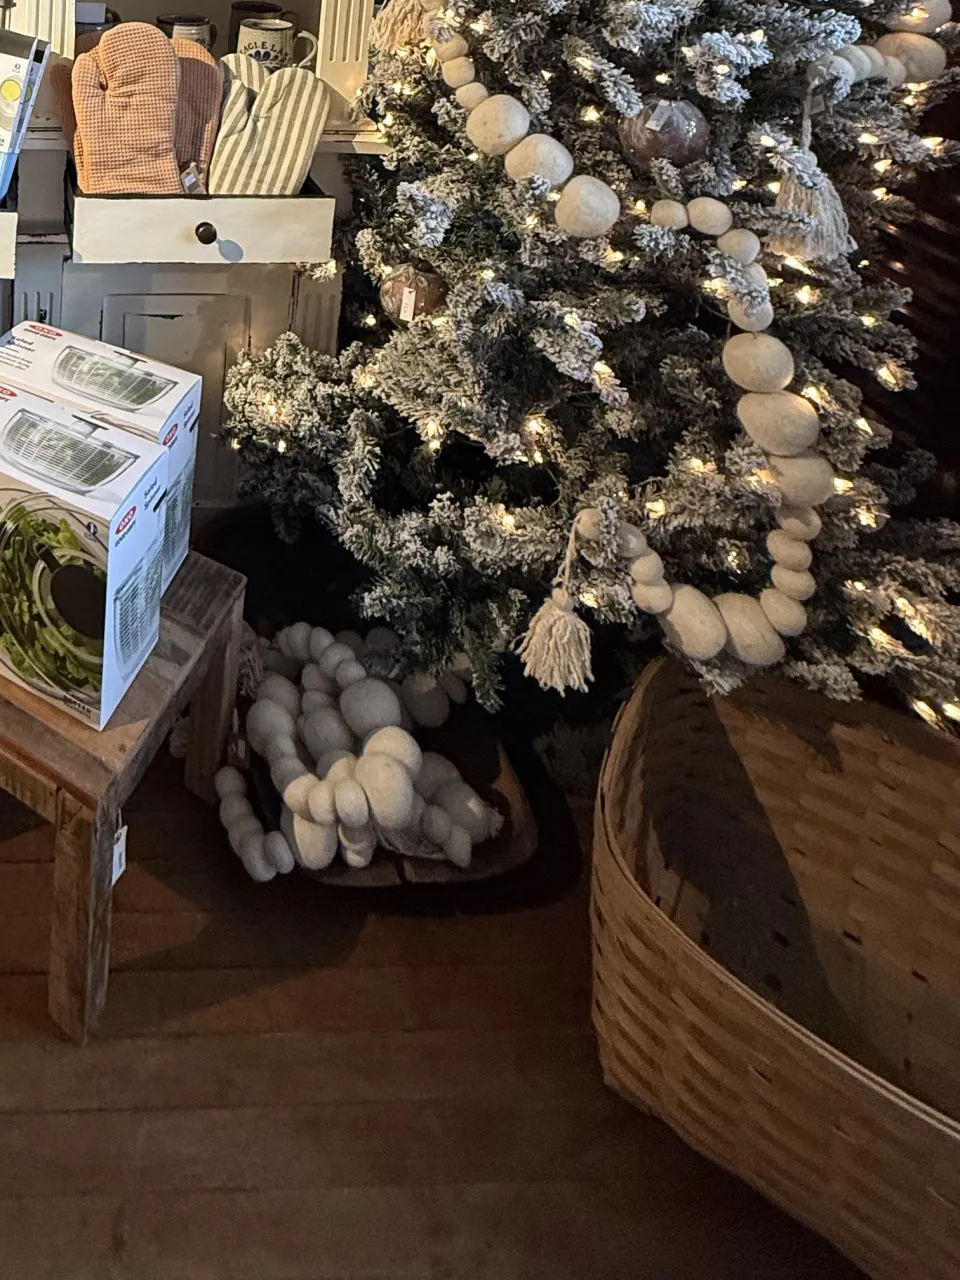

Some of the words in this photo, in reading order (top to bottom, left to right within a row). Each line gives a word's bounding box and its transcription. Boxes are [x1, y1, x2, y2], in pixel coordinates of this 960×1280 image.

[34, 325, 57, 335] OXO
[143, 475, 159, 500] Salad
[143, 484, 162, 511] Spinner
[119, 509, 134, 529] OXO
